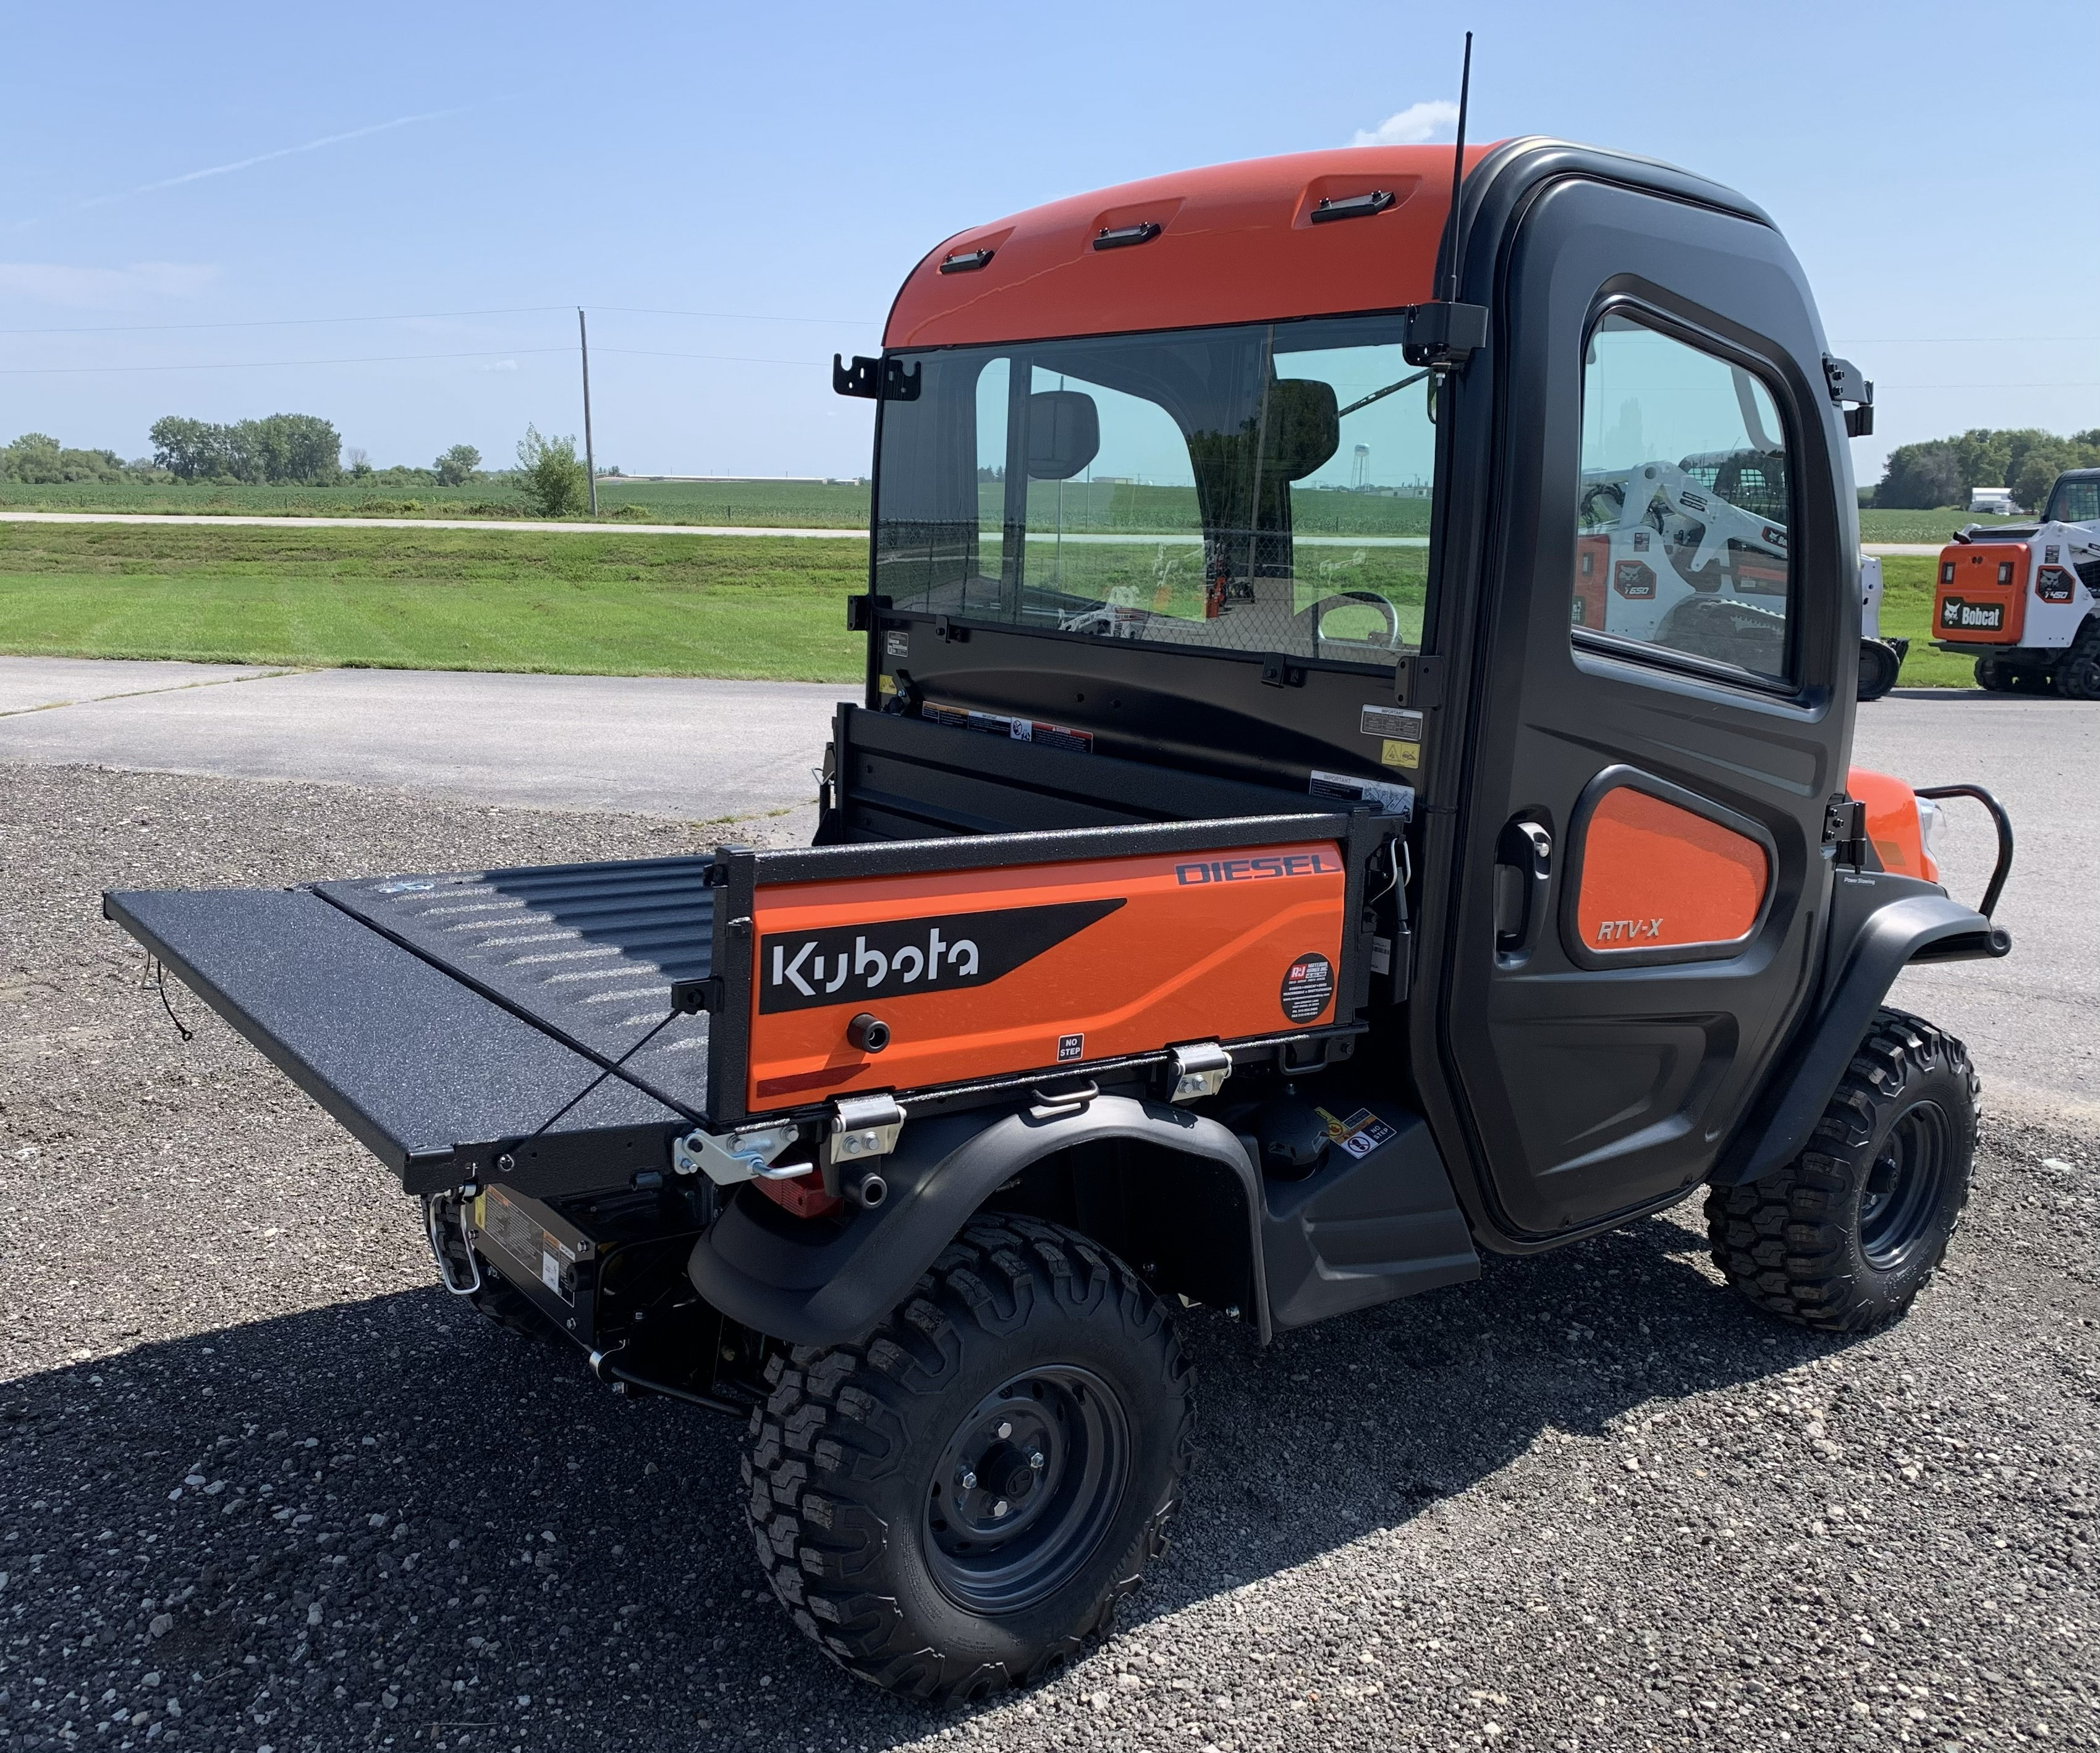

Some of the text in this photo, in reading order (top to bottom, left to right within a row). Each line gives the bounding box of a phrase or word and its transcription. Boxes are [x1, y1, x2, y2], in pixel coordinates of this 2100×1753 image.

[1962, 607, 2000, 627] Bobcat
[1323, 774, 1352, 784] IMPORTANT
[1175, 855, 1341, 885] DIESEL
[1858, 877, 1876, 885] Steering
[1597, 918, 1664, 940] RTV-X
[773, 927, 979, 996] Kubota
[1065, 1038, 1078, 1047] NO
[1060, 1047, 1081, 1057] STEP
[1370, 1125, 1381, 1133] NO
[1373, 1127, 1389, 1139] STEP
